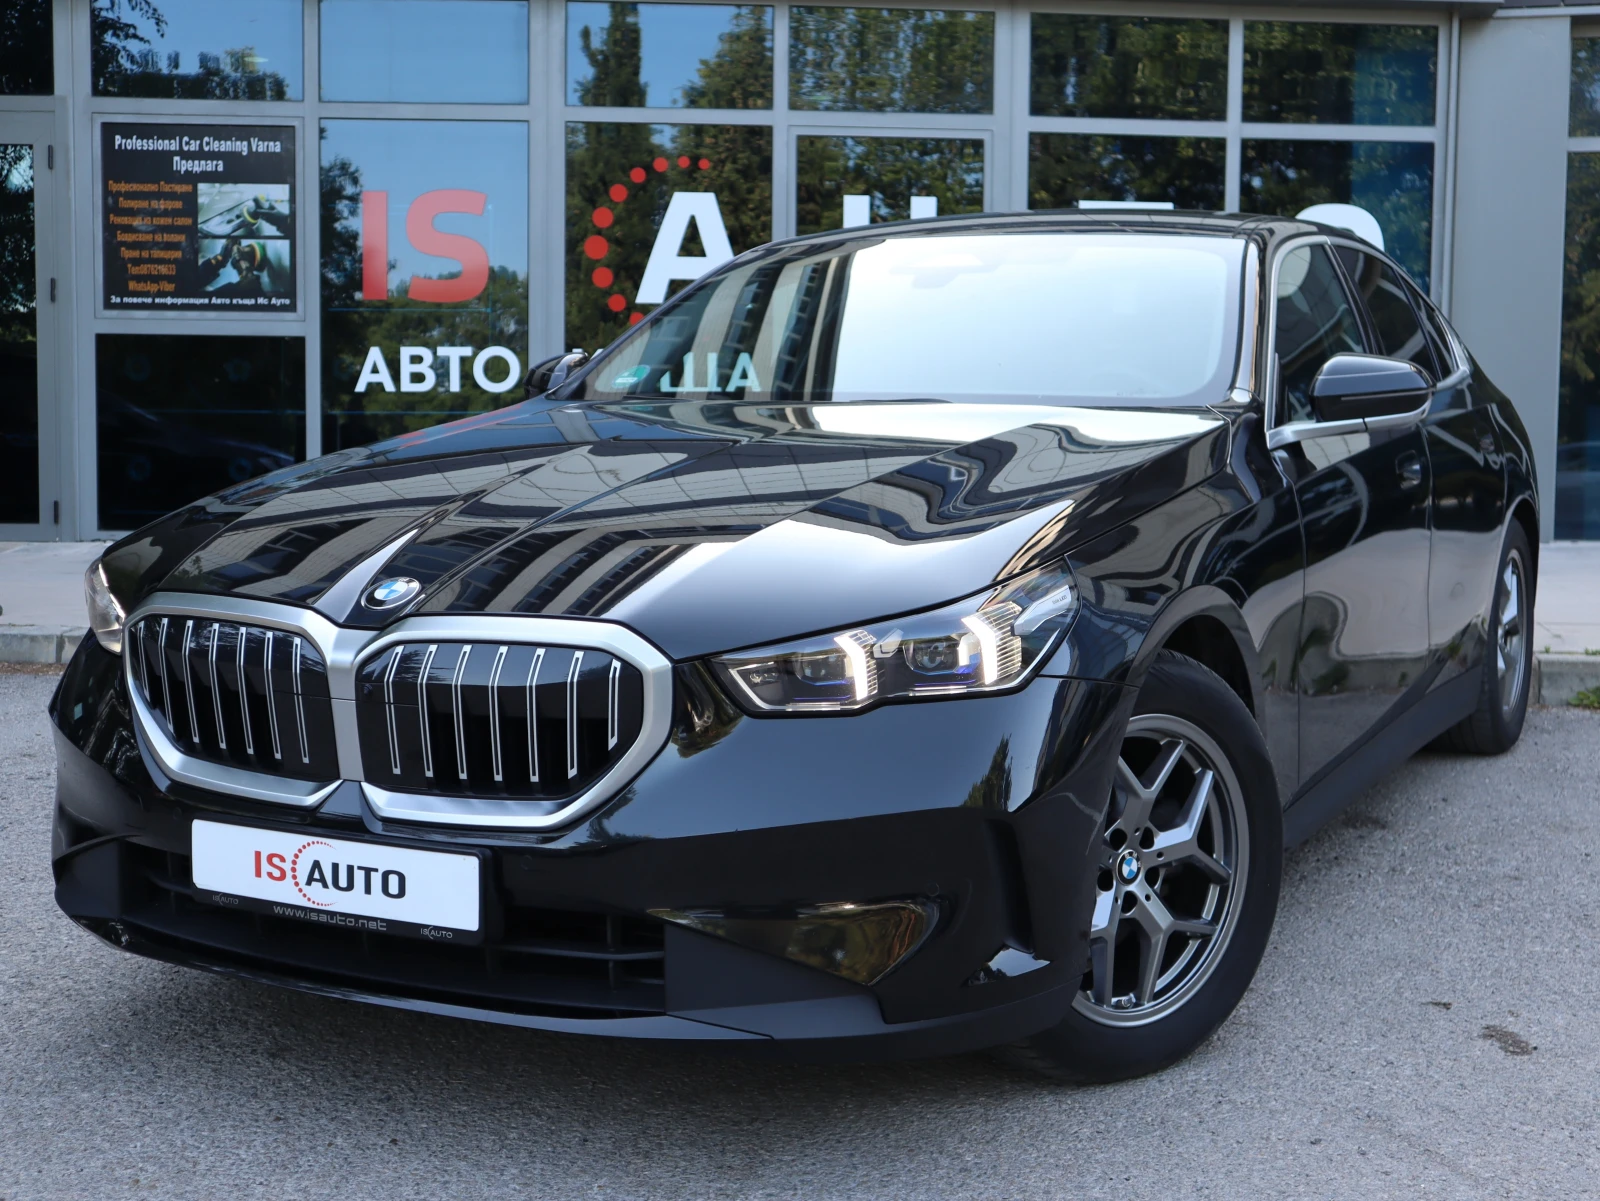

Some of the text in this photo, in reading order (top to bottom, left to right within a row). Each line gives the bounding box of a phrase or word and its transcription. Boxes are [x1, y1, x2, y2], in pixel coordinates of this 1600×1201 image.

[114, 134, 281, 156] Professional Car Cleaning Varna
[172, 155, 224, 175] Предлага
[361, 188, 490, 304] IS
[110, 295, 121, 304] За
[122, 296, 153, 304] повече
[154, 296, 209, 306] информация
[210, 296, 231, 305] Авто
[232, 298, 256, 306] къща
[270, 297, 291, 307] Ауто
[354, 345, 521, 393] АВТО
[254, 850, 406, 899] IS AUTO
[273, 905, 387, 931] www.isauto.net
[430, 930, 453, 938] AUTO
